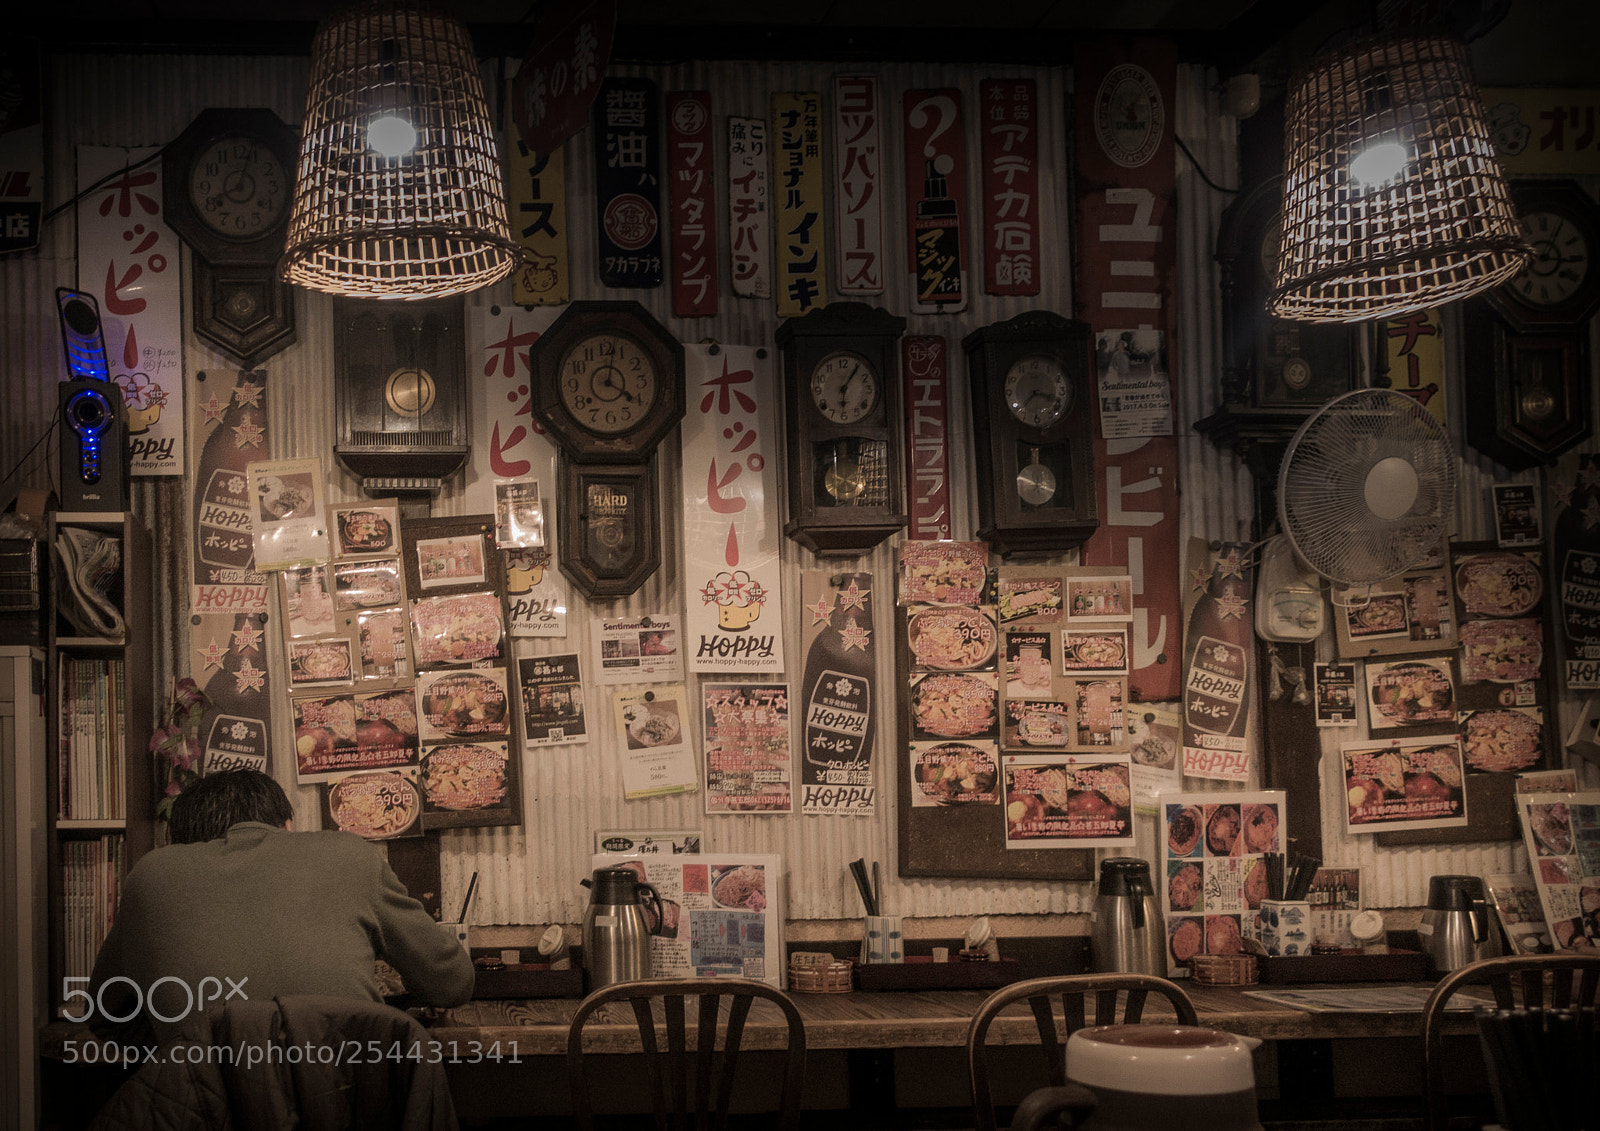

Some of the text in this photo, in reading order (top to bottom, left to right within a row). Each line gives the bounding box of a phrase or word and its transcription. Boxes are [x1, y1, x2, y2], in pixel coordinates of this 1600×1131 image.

[803, 99, 818, 158] 万年筆用
[1540, 106, 1600, 151] オリ
[781, 110, 804, 210] ナショナル
[839, 79, 877, 286] ヨツバソース
[732, 170, 759, 281] イチバン
[100, 158, 167, 369] ホッピー
[584, 348, 594, 361] 11
[600, 342, 615, 356] 12
[619, 346, 625, 359] 1
[572, 360, 586, 375] 10
[629, 357, 641, 371] 2
[568, 379, 579, 393] 9
[636, 375, 648, 389] 3
[1102, 380, 1148, 391] Sentimental
[484, 315, 549, 477] ホッピ
[574, 395, 586, 410] 8
[633, 393, 643, 406] 4
[589, 408, 600, 422] 7
[605, 411, 616, 424] 6
[621, 407, 632, 421] 5
[1100, 188, 1169, 671] ユニビール
[130, 438, 175, 460] ppy
[700, 353, 765, 567] ホッピー
[205, 530, 248, 551] ホッピー
[1501, 574, 1537, 586] 390円
[195, 585, 268, 607] Hoppy
[508, 598, 557, 622] ppy
[603, 621, 671, 631] Sentimen boys
[952, 628, 991, 640] 390円
[696, 634, 775, 658] Hoppy
[696, 658, 777, 667] www.hoppy-happy.com
[1189, 670, 1243, 699] Hoppy
[1190, 696, 1230, 718] ホッピー
[809, 706, 867, 731] Hoppy
[811, 732, 854, 752] ホッピー
[1183, 747, 1250, 774] Hoppy
[375, 792, 413, 807] 390円
[802, 785, 874, 807] Hoppy
[803, 806, 873, 814] www.hoppy-happy.com
